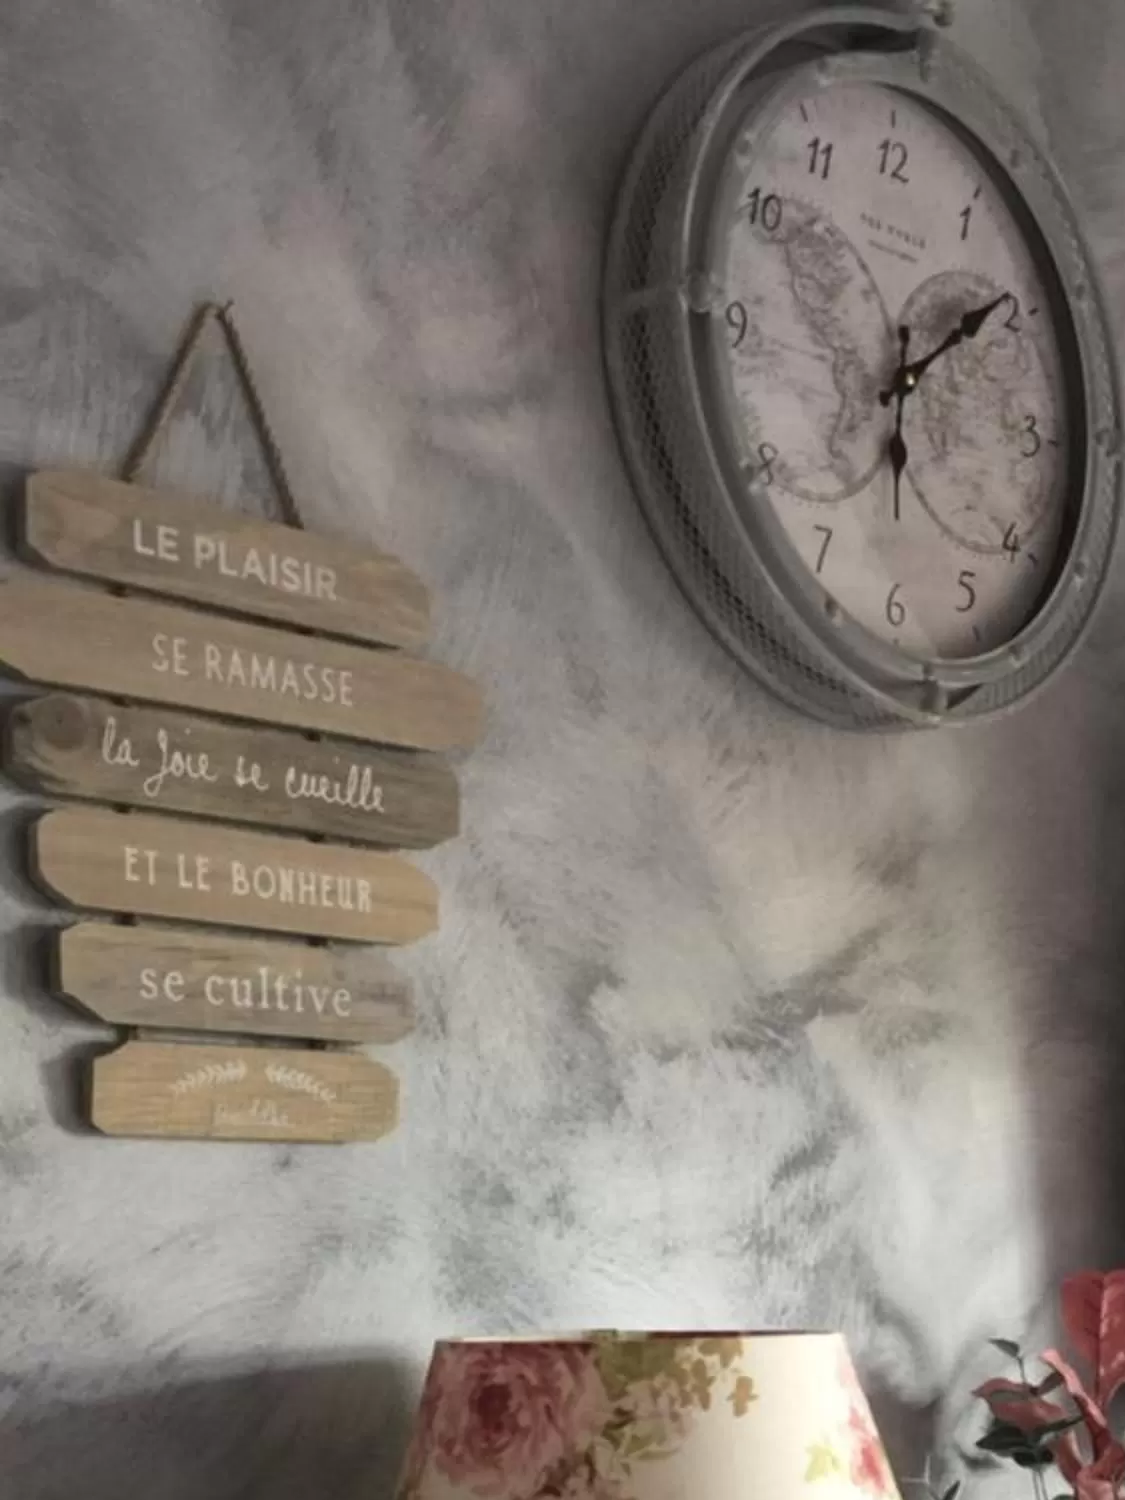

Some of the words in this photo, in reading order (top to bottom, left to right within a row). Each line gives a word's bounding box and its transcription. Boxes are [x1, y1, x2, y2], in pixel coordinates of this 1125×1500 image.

[808, 136, 833, 181] 11
[877, 138, 909, 183] 12
[747, 187, 782, 232] 10
[959, 204, 972, 241] 1
[725, 301, 747, 348] 9
[1003, 292, 1020, 333] 2
[1019, 415, 1041, 457] 3
[757, 441, 778, 486] 8
[133, 519, 180, 561] LE
[194, 536, 337, 600] PLAISIR
[813, 524, 833, 573] 7
[1001, 522, 1021, 563] 4
[886, 583, 905, 627] 6
[955, 570, 976, 612] 5
[152, 633, 189, 676] SE
[204, 643, 354, 707] RAMASSE
[102, 716, 140, 766] la
[235, 755, 268, 790] se
[284, 757, 386, 813] cueille
[124, 847, 160, 886] ET
[177, 854, 211, 892] LE
[231, 861, 372, 913] BONHEUR
[139, 967, 185, 1001] se
[205, 967, 352, 1017] cultive
